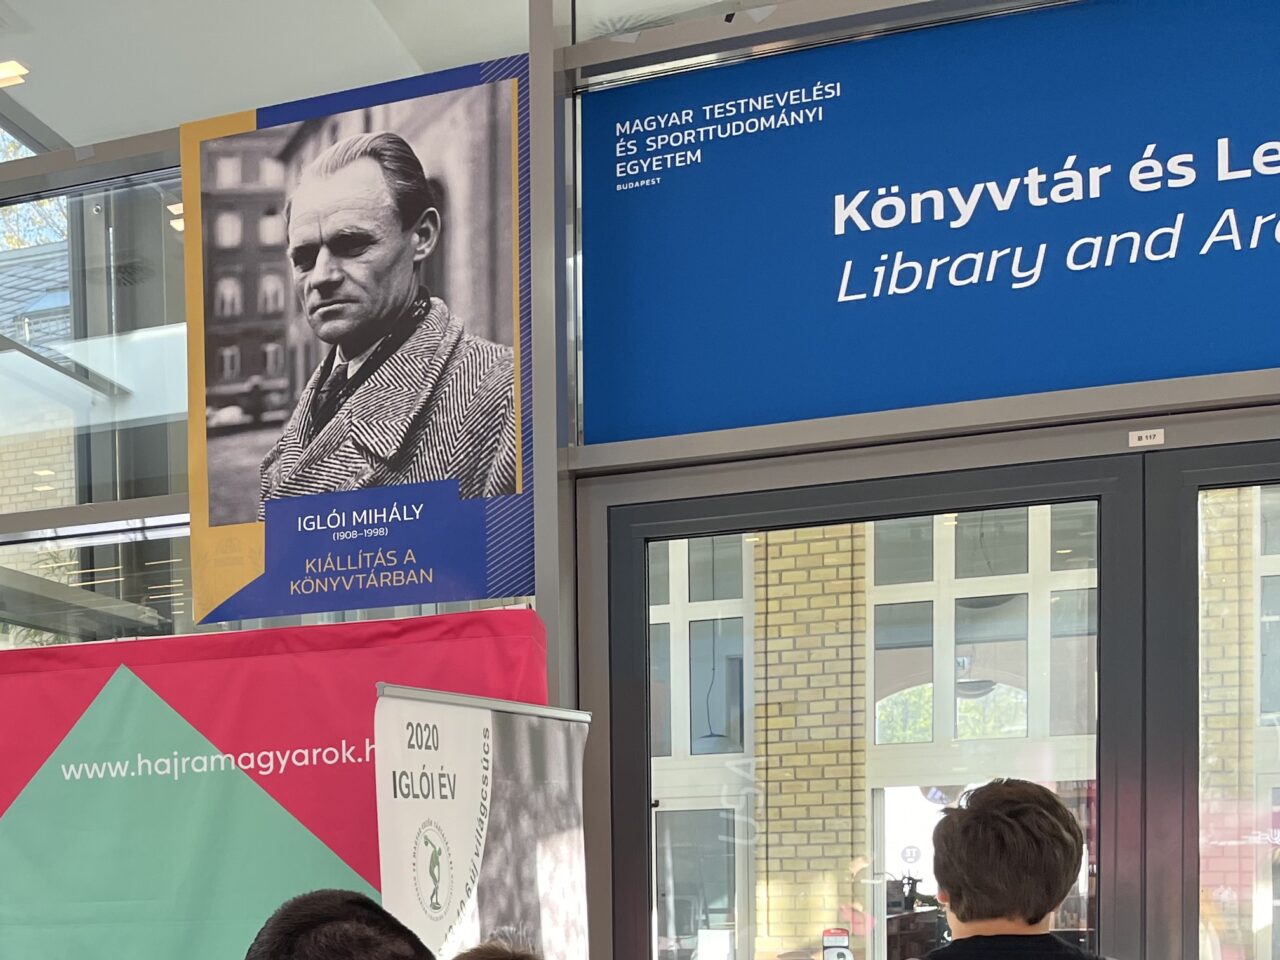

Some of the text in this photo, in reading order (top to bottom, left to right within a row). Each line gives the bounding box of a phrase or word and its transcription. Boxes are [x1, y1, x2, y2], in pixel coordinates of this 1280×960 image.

[615, 81, 841, 137] MAGYAR TESTNEVELÉSI
[615, 107, 823, 157] ÉS SPORTTUDOMÁNYI
[615, 149, 702, 178] EGYETEM
[615, 177, 662, 191] BUDAPEST
[833, 136, 1280, 236] Könyvtár és Le
[836, 207, 1280, 302] Library and Ar
[297, 501, 424, 532] IGLÓI MIHÁLY
[305, 548, 417, 574] KIÁLLÍTÁS A
[289, 566, 434, 596] KÖNYVTÁRBAN
[405, 721, 440, 751] 2020
[392, 764, 457, 800] IGLÓI ÉV
